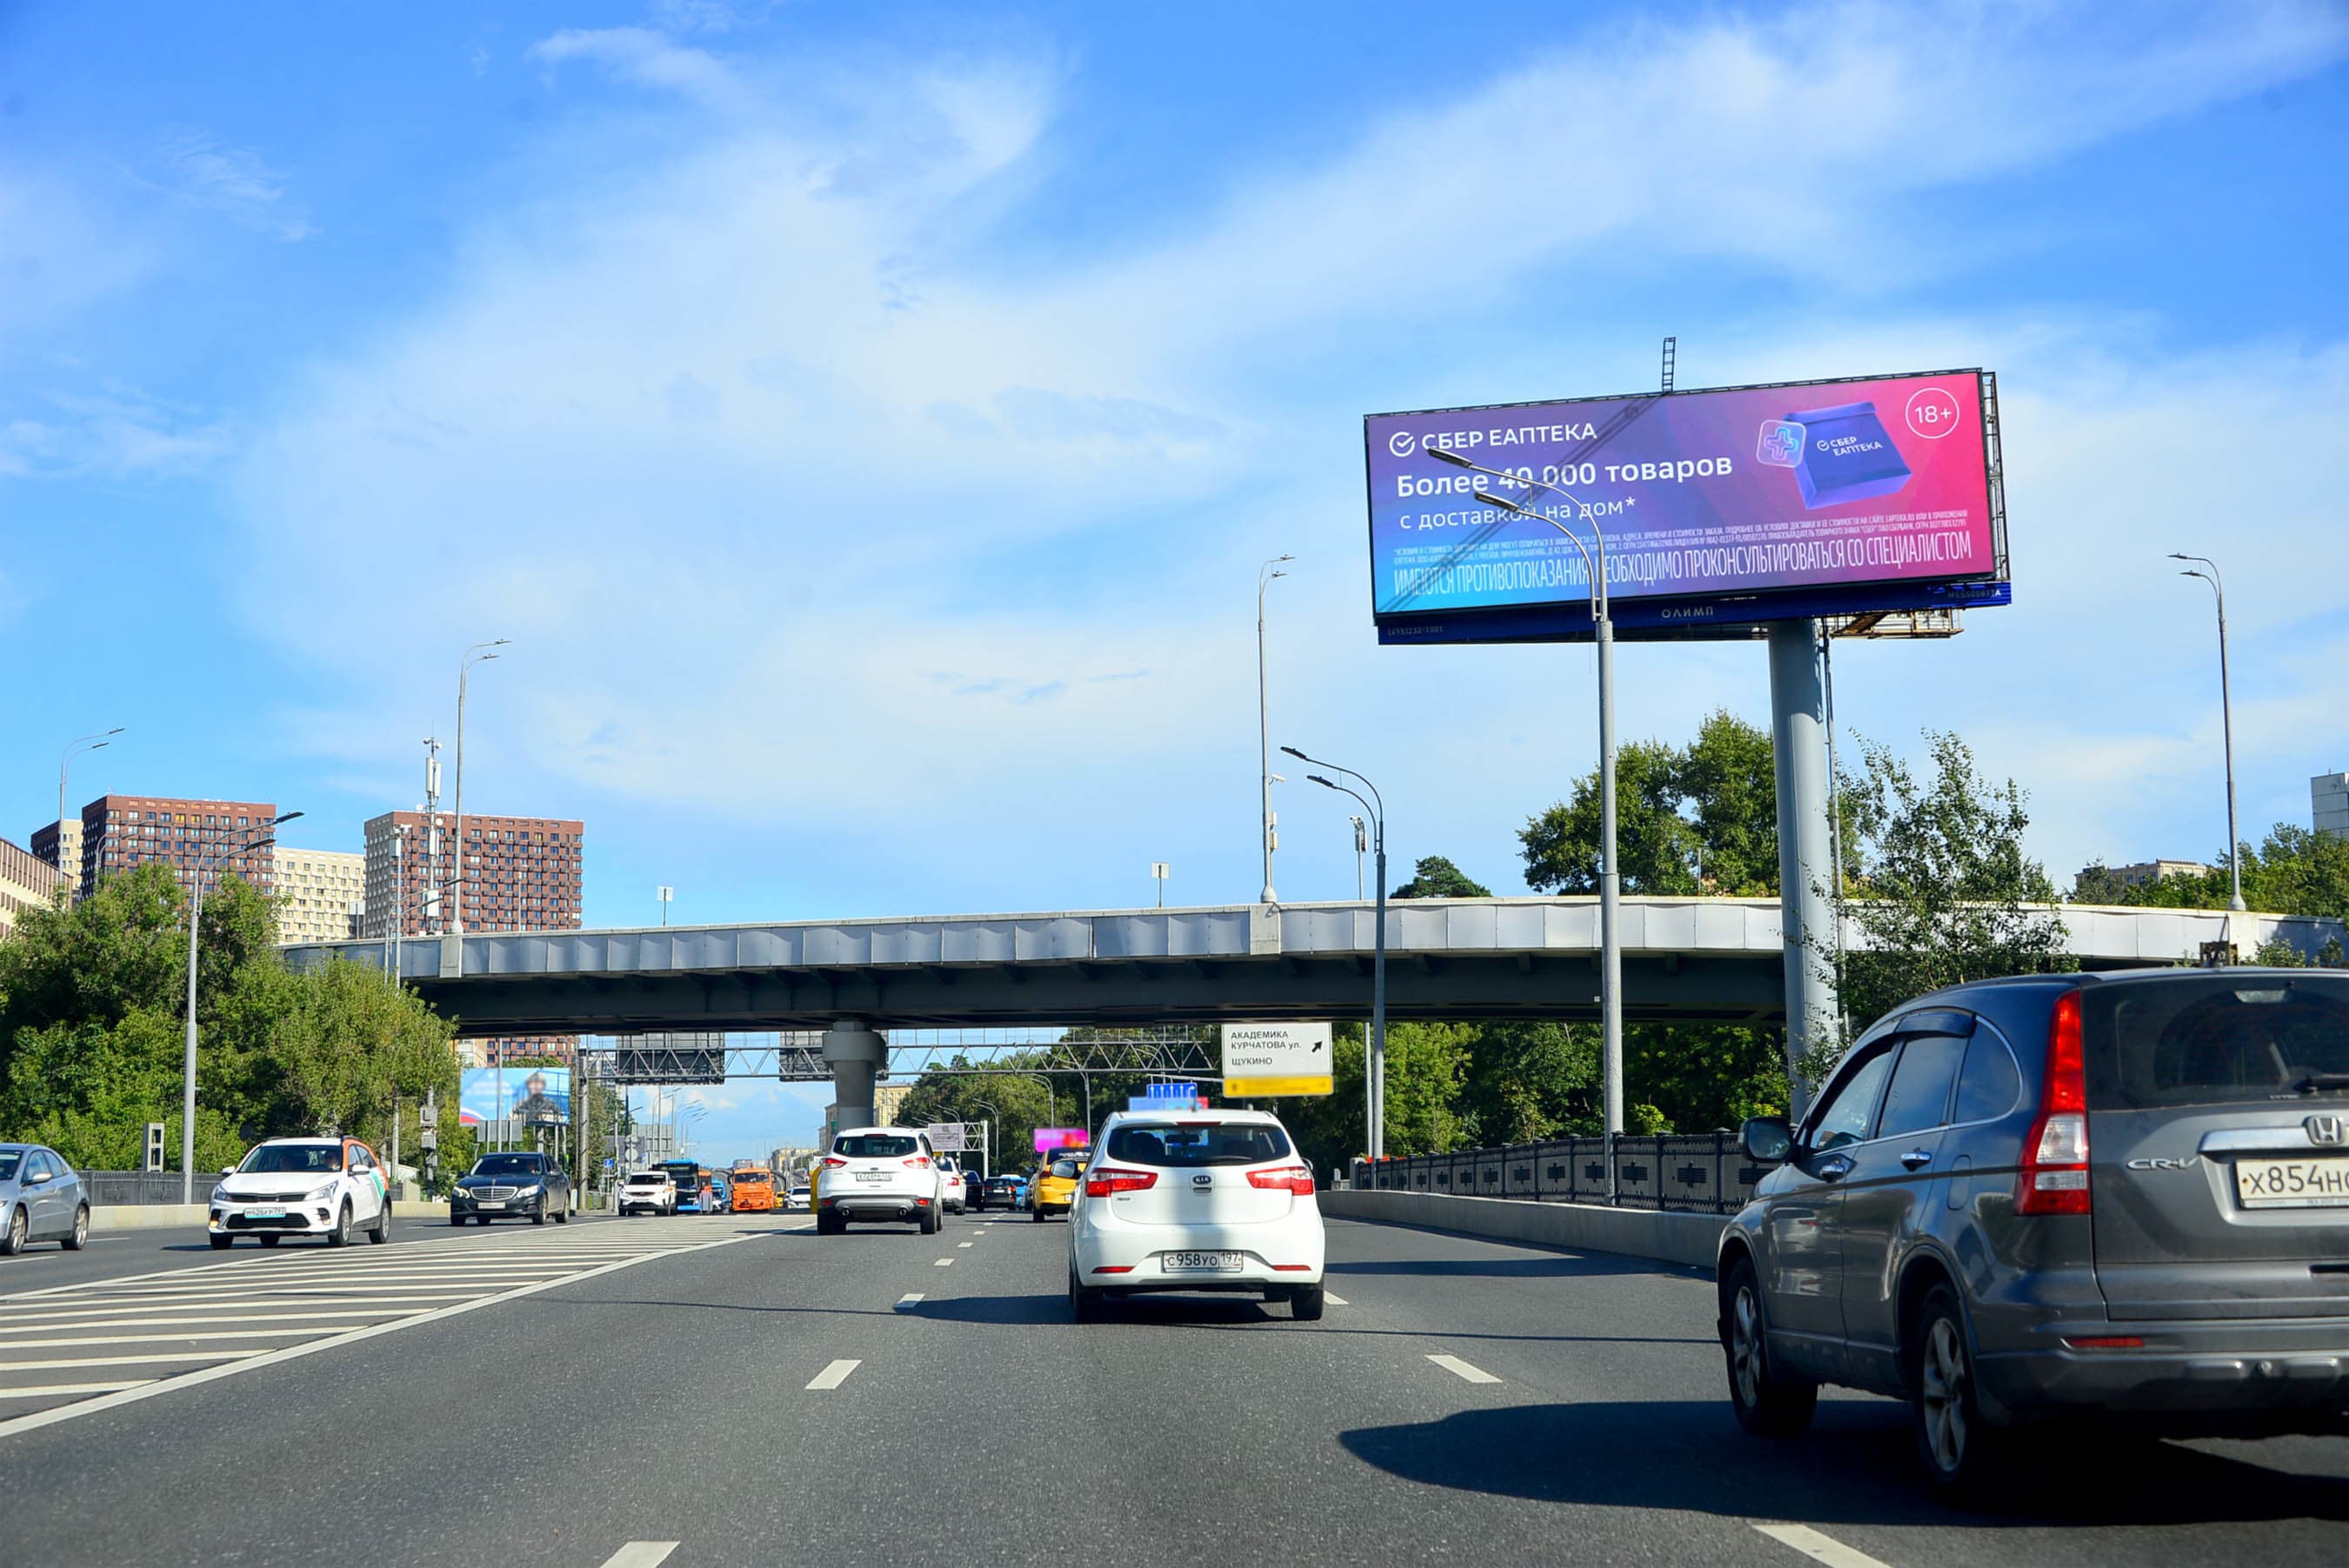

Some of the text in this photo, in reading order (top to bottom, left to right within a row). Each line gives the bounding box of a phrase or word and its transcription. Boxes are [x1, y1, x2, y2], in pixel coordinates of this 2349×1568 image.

[1914, 405, 1952, 424] 18+
[1421, 423, 1598, 450] СБЕР ЕАПТЕКА
[1830, 436, 1858, 448] СБЕР
[1833, 440, 1883, 457] ЕАПТЕКА
[1397, 457, 1733, 497] Более 40 000 товаров
[1399, 515, 1411, 529] с
[1418, 501, 1537, 530] доставкой
[1545, 504, 1571, 519] на
[1456, 556, 1590, 593] ПРОТИВОПОКАЗАНИЯ
[1684, 537, 1845, 579] ПРОКОНСУЛЬТИРОВАТЬСЯ
[1846, 537, 1864, 568] СО
[1865, 530, 1972, 570] СПЕЦИАЛИСТОМ
[1661, 606, 1713, 618] ОЛИМП
[1231, 1031, 1289, 1039] АКАДЕМИКА
[1231, 1041, 1286, 1050] КУРЧАТОВА
[1231, 1057, 1273, 1066] ЩУКИНО
[2127, 1157, 2199, 1171] CR-V
